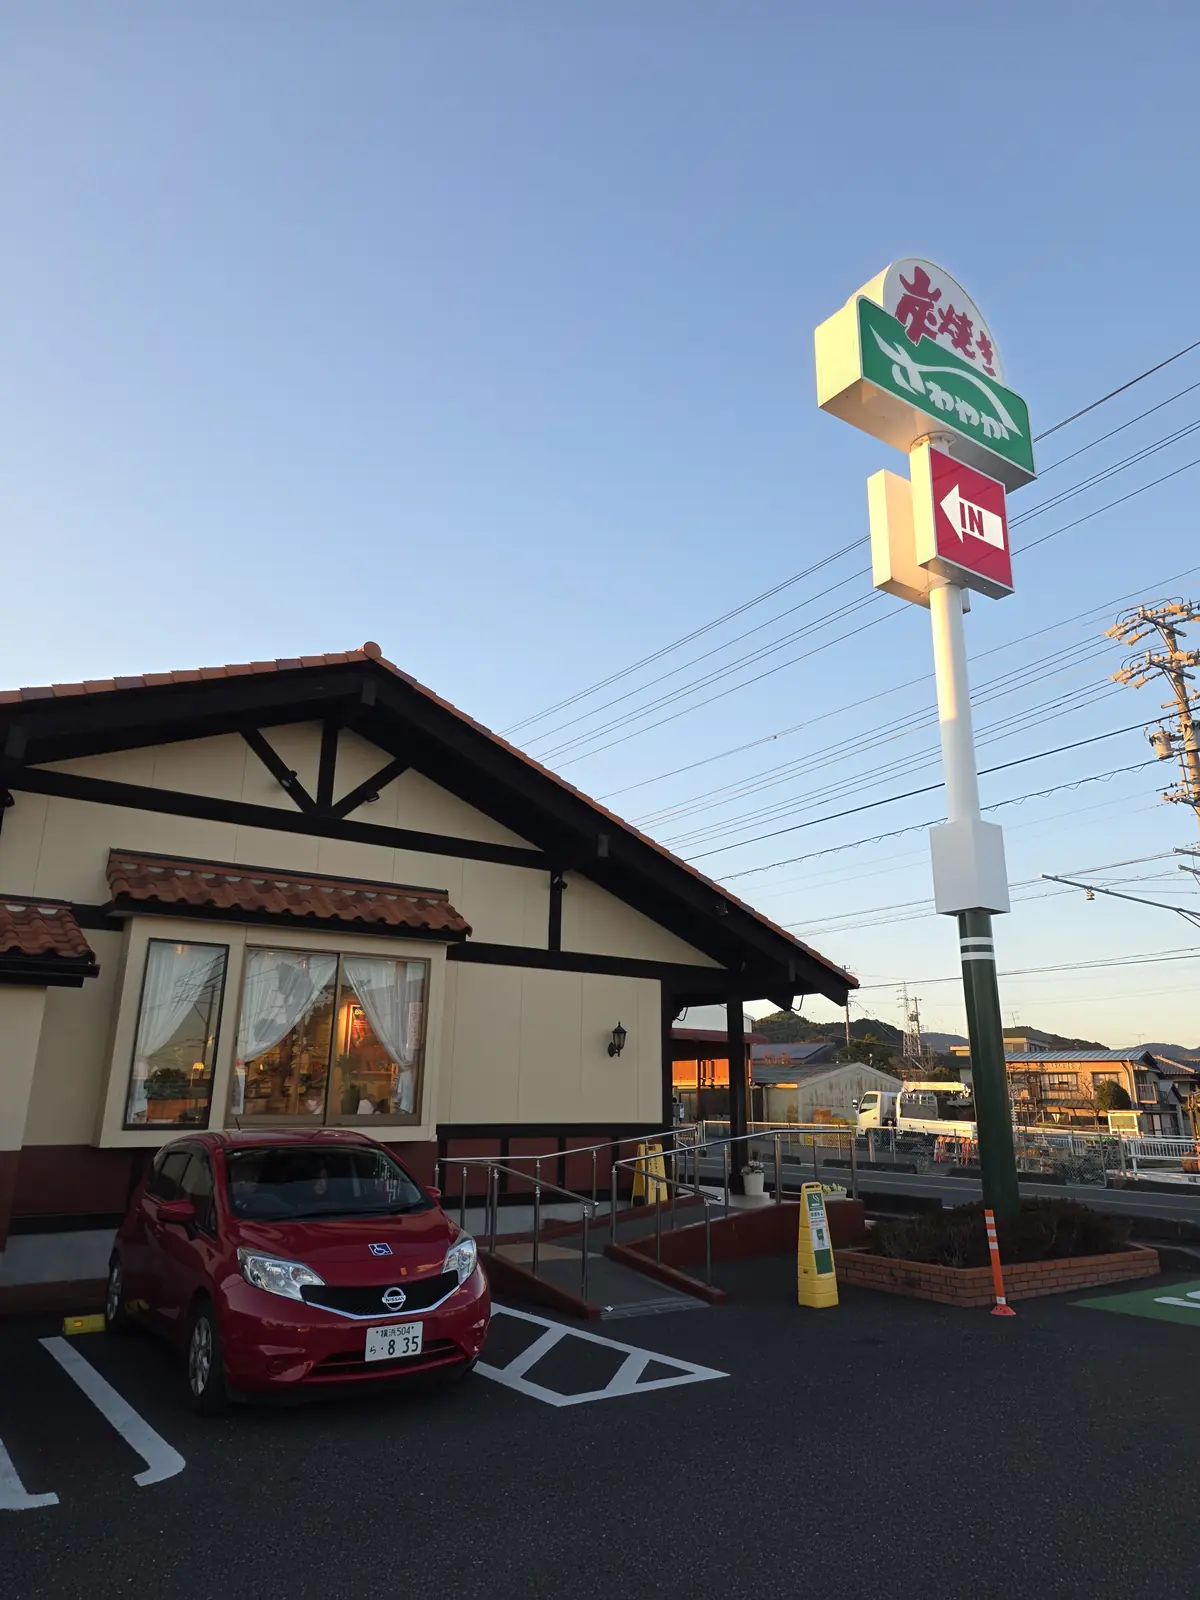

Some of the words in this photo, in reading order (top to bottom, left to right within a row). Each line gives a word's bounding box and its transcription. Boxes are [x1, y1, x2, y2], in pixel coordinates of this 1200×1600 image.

[895, 266, 997, 377] 炭焼き
[869, 324, 1024, 440] さわやか
[959, 501, 985, 538] IN
